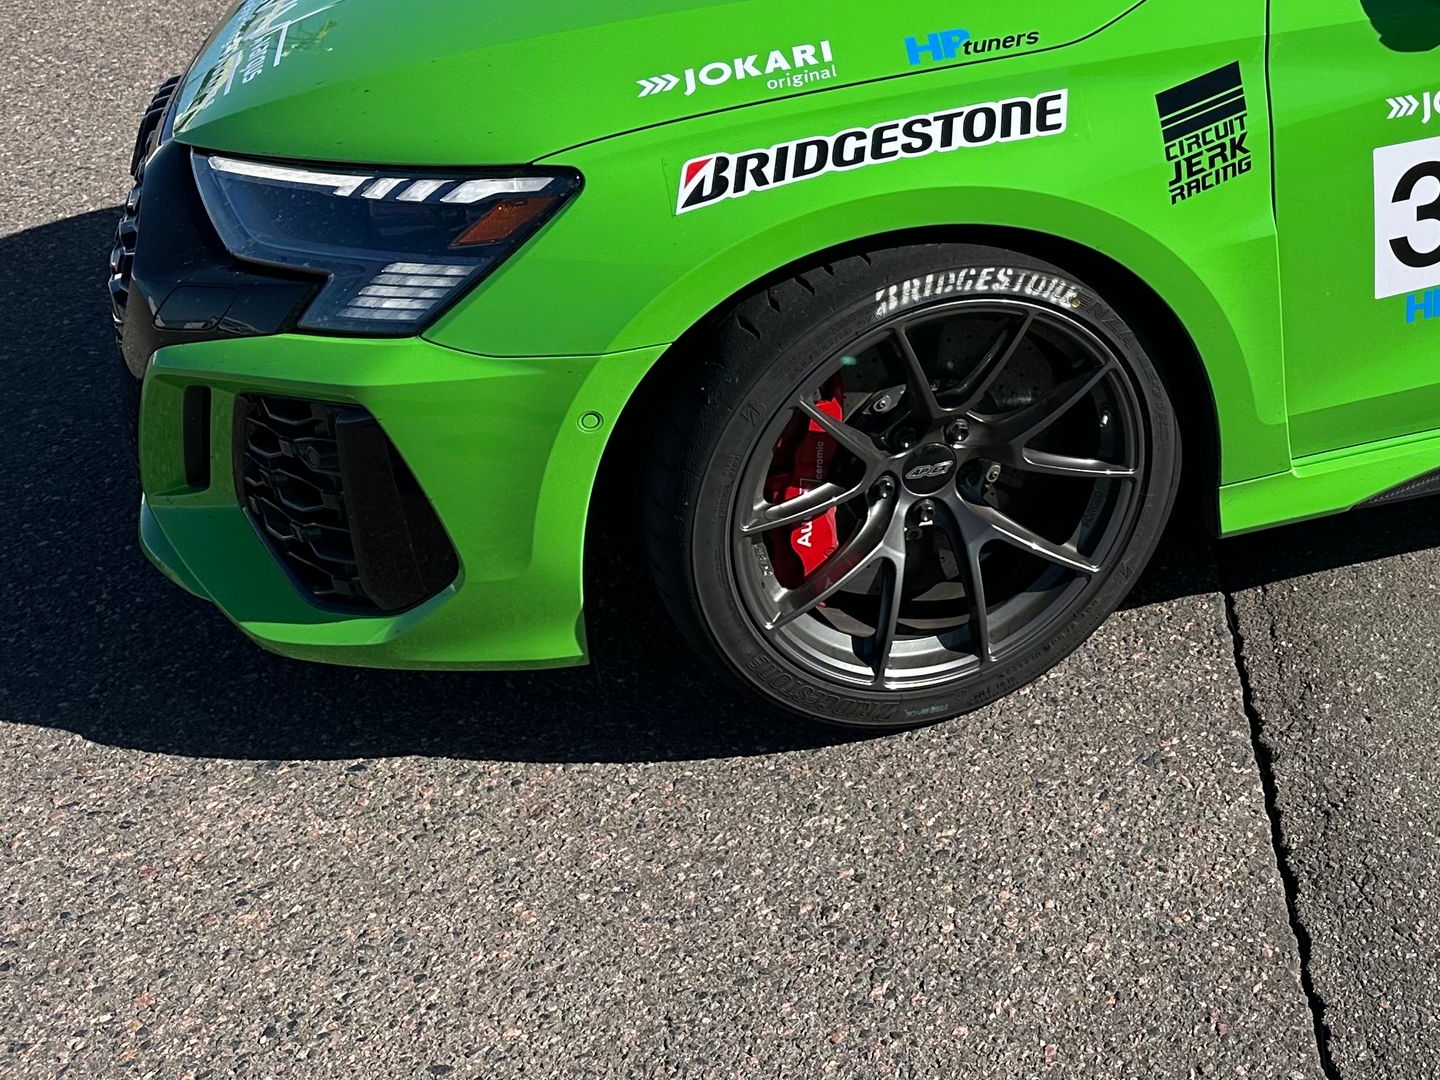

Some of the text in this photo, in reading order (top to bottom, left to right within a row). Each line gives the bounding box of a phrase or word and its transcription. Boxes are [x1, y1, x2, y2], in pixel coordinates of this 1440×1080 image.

[683, 40, 833, 97] JOKARI
[766, 64, 838, 90] original
[680, 93, 1063, 209] BRIDGESTONE
[1165, 112, 1248, 162] CIRCUIT
[1168, 131, 1251, 187] JERK
[1168, 155, 1252, 205] RACING
[816, 440, 824, 480] ceramic
